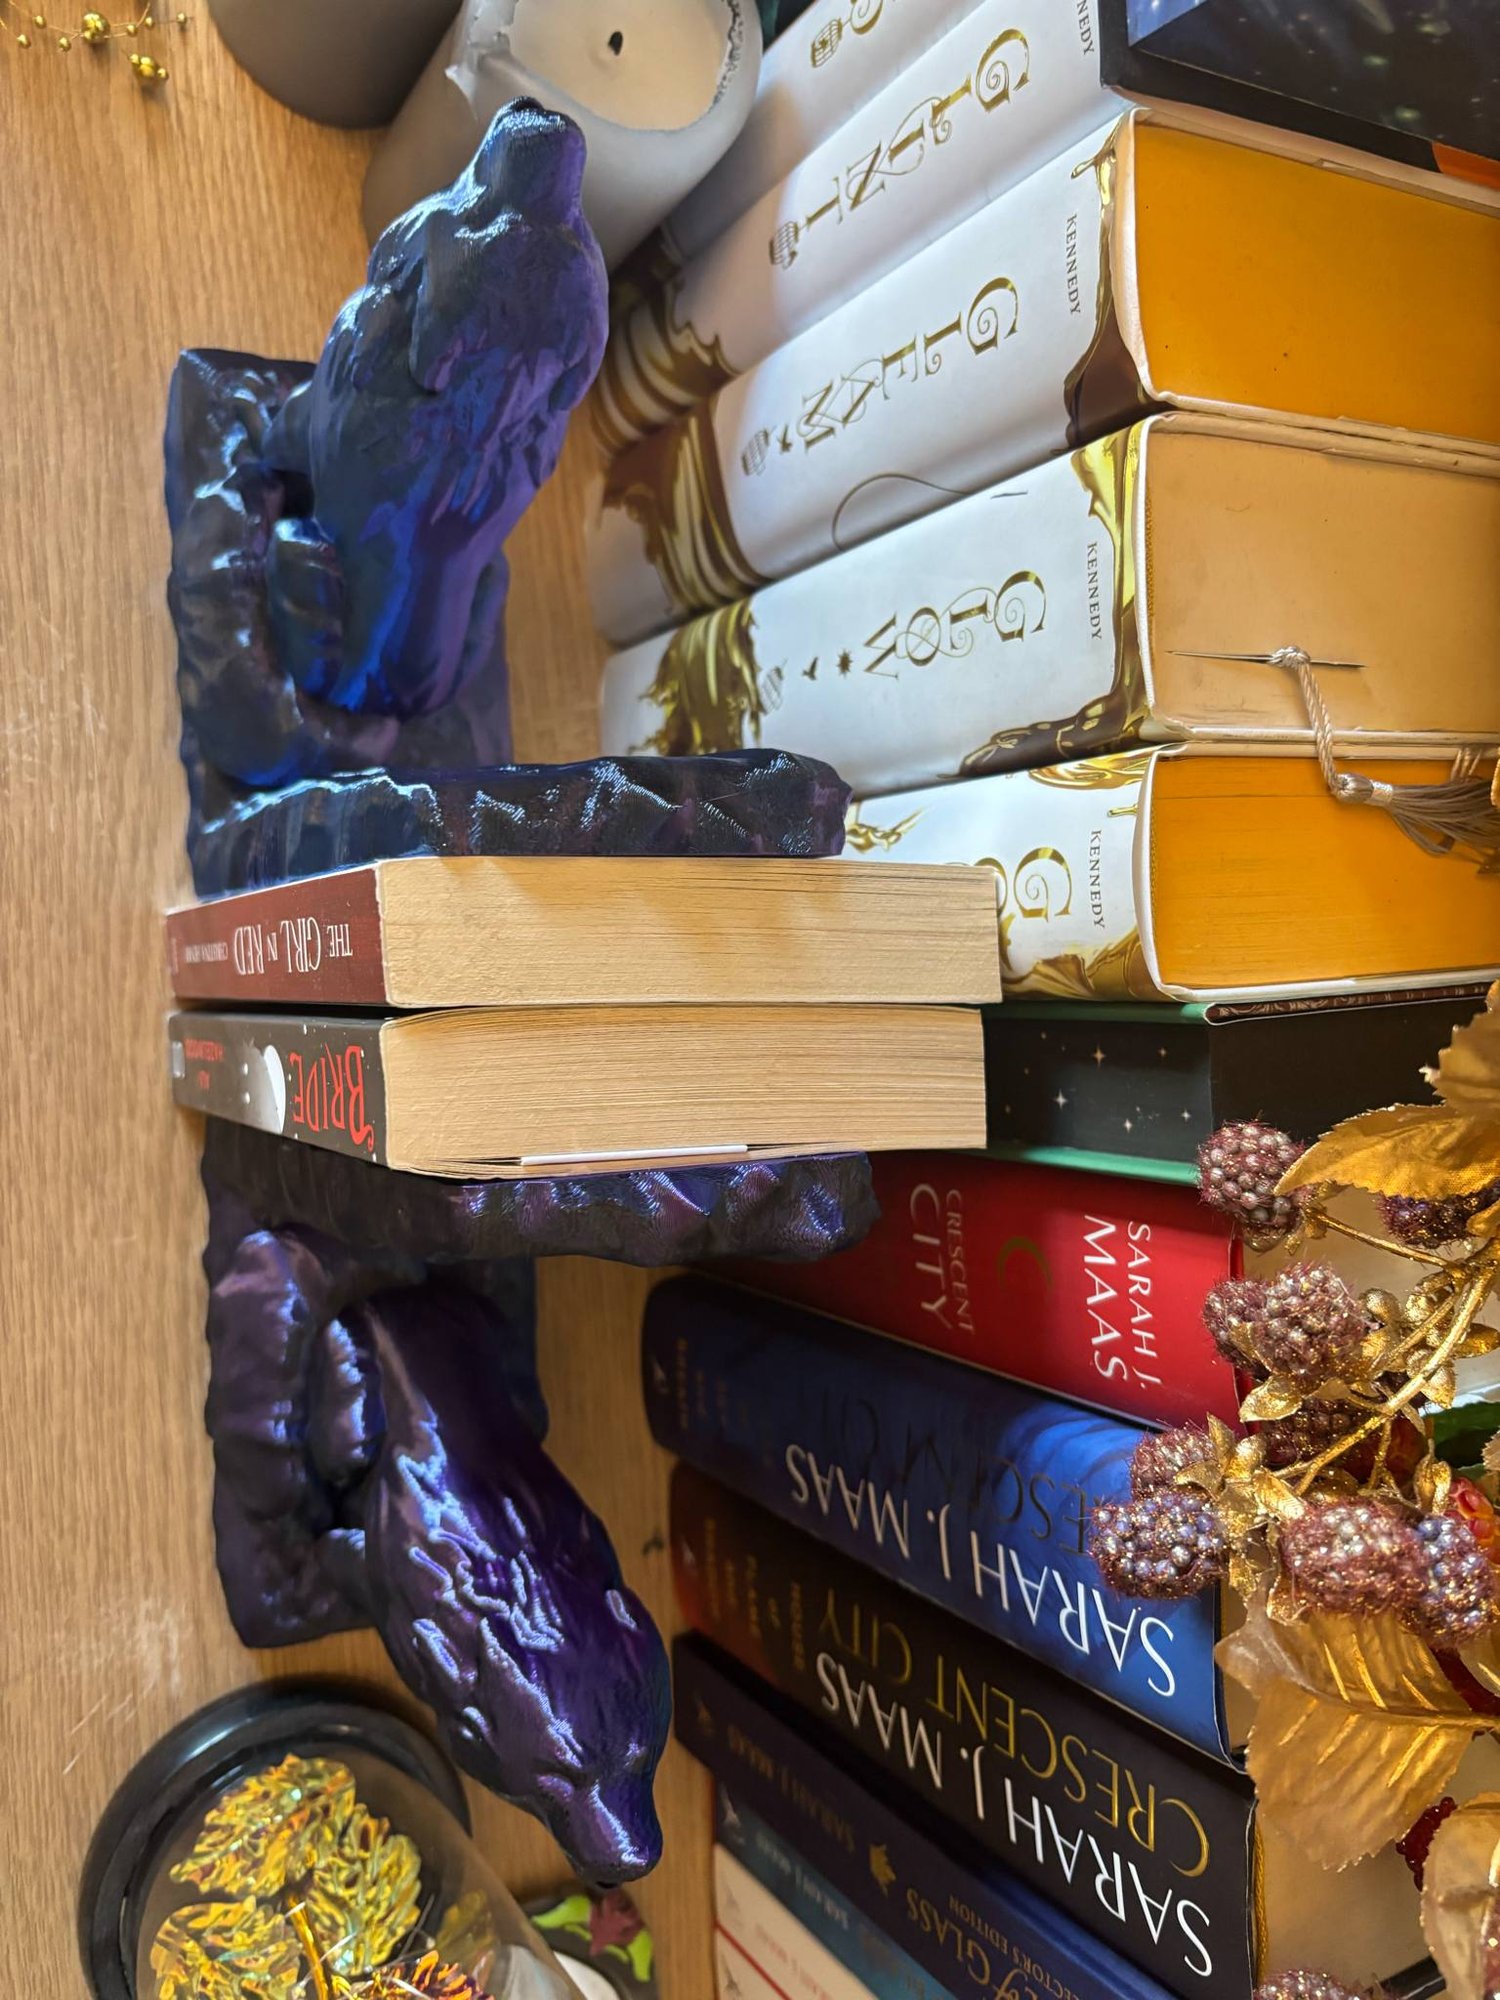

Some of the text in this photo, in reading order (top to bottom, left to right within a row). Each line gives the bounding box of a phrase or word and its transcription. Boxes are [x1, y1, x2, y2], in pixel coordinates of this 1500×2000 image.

[1076, 0, 1095, 55] NEDY
[1064, 213, 1081, 316] KENNEDY
[1086, 541, 1103, 641] KENNEDY
[1089, 829, 1106, 929] KENNEDY
[233, 916, 353, 976] THE GIRL IN RED
[288, 1043, 375, 1152] BRIDE
[909, 1183, 953, 1330] CITY
[945, 1187, 976, 1335] CRESCENT
[1083, 1214, 1128, 1381] MAAS
[1127, 1220, 1162, 1389] SARAH J.
[785, 1443, 1176, 1697] SARAH J. MAAS
[816, 1587, 912, 1686] CITY
[816, 1651, 943, 1790] MAAS
[926, 1653, 1211, 1878] CRESCENT
[959, 1744, 985, 1821] J.
[1004, 1777, 1213, 1977] SARAH
[906, 1887, 992, 1986] GLASS
[950, 1896, 1080, 2000] ECTOR'S EDITION
